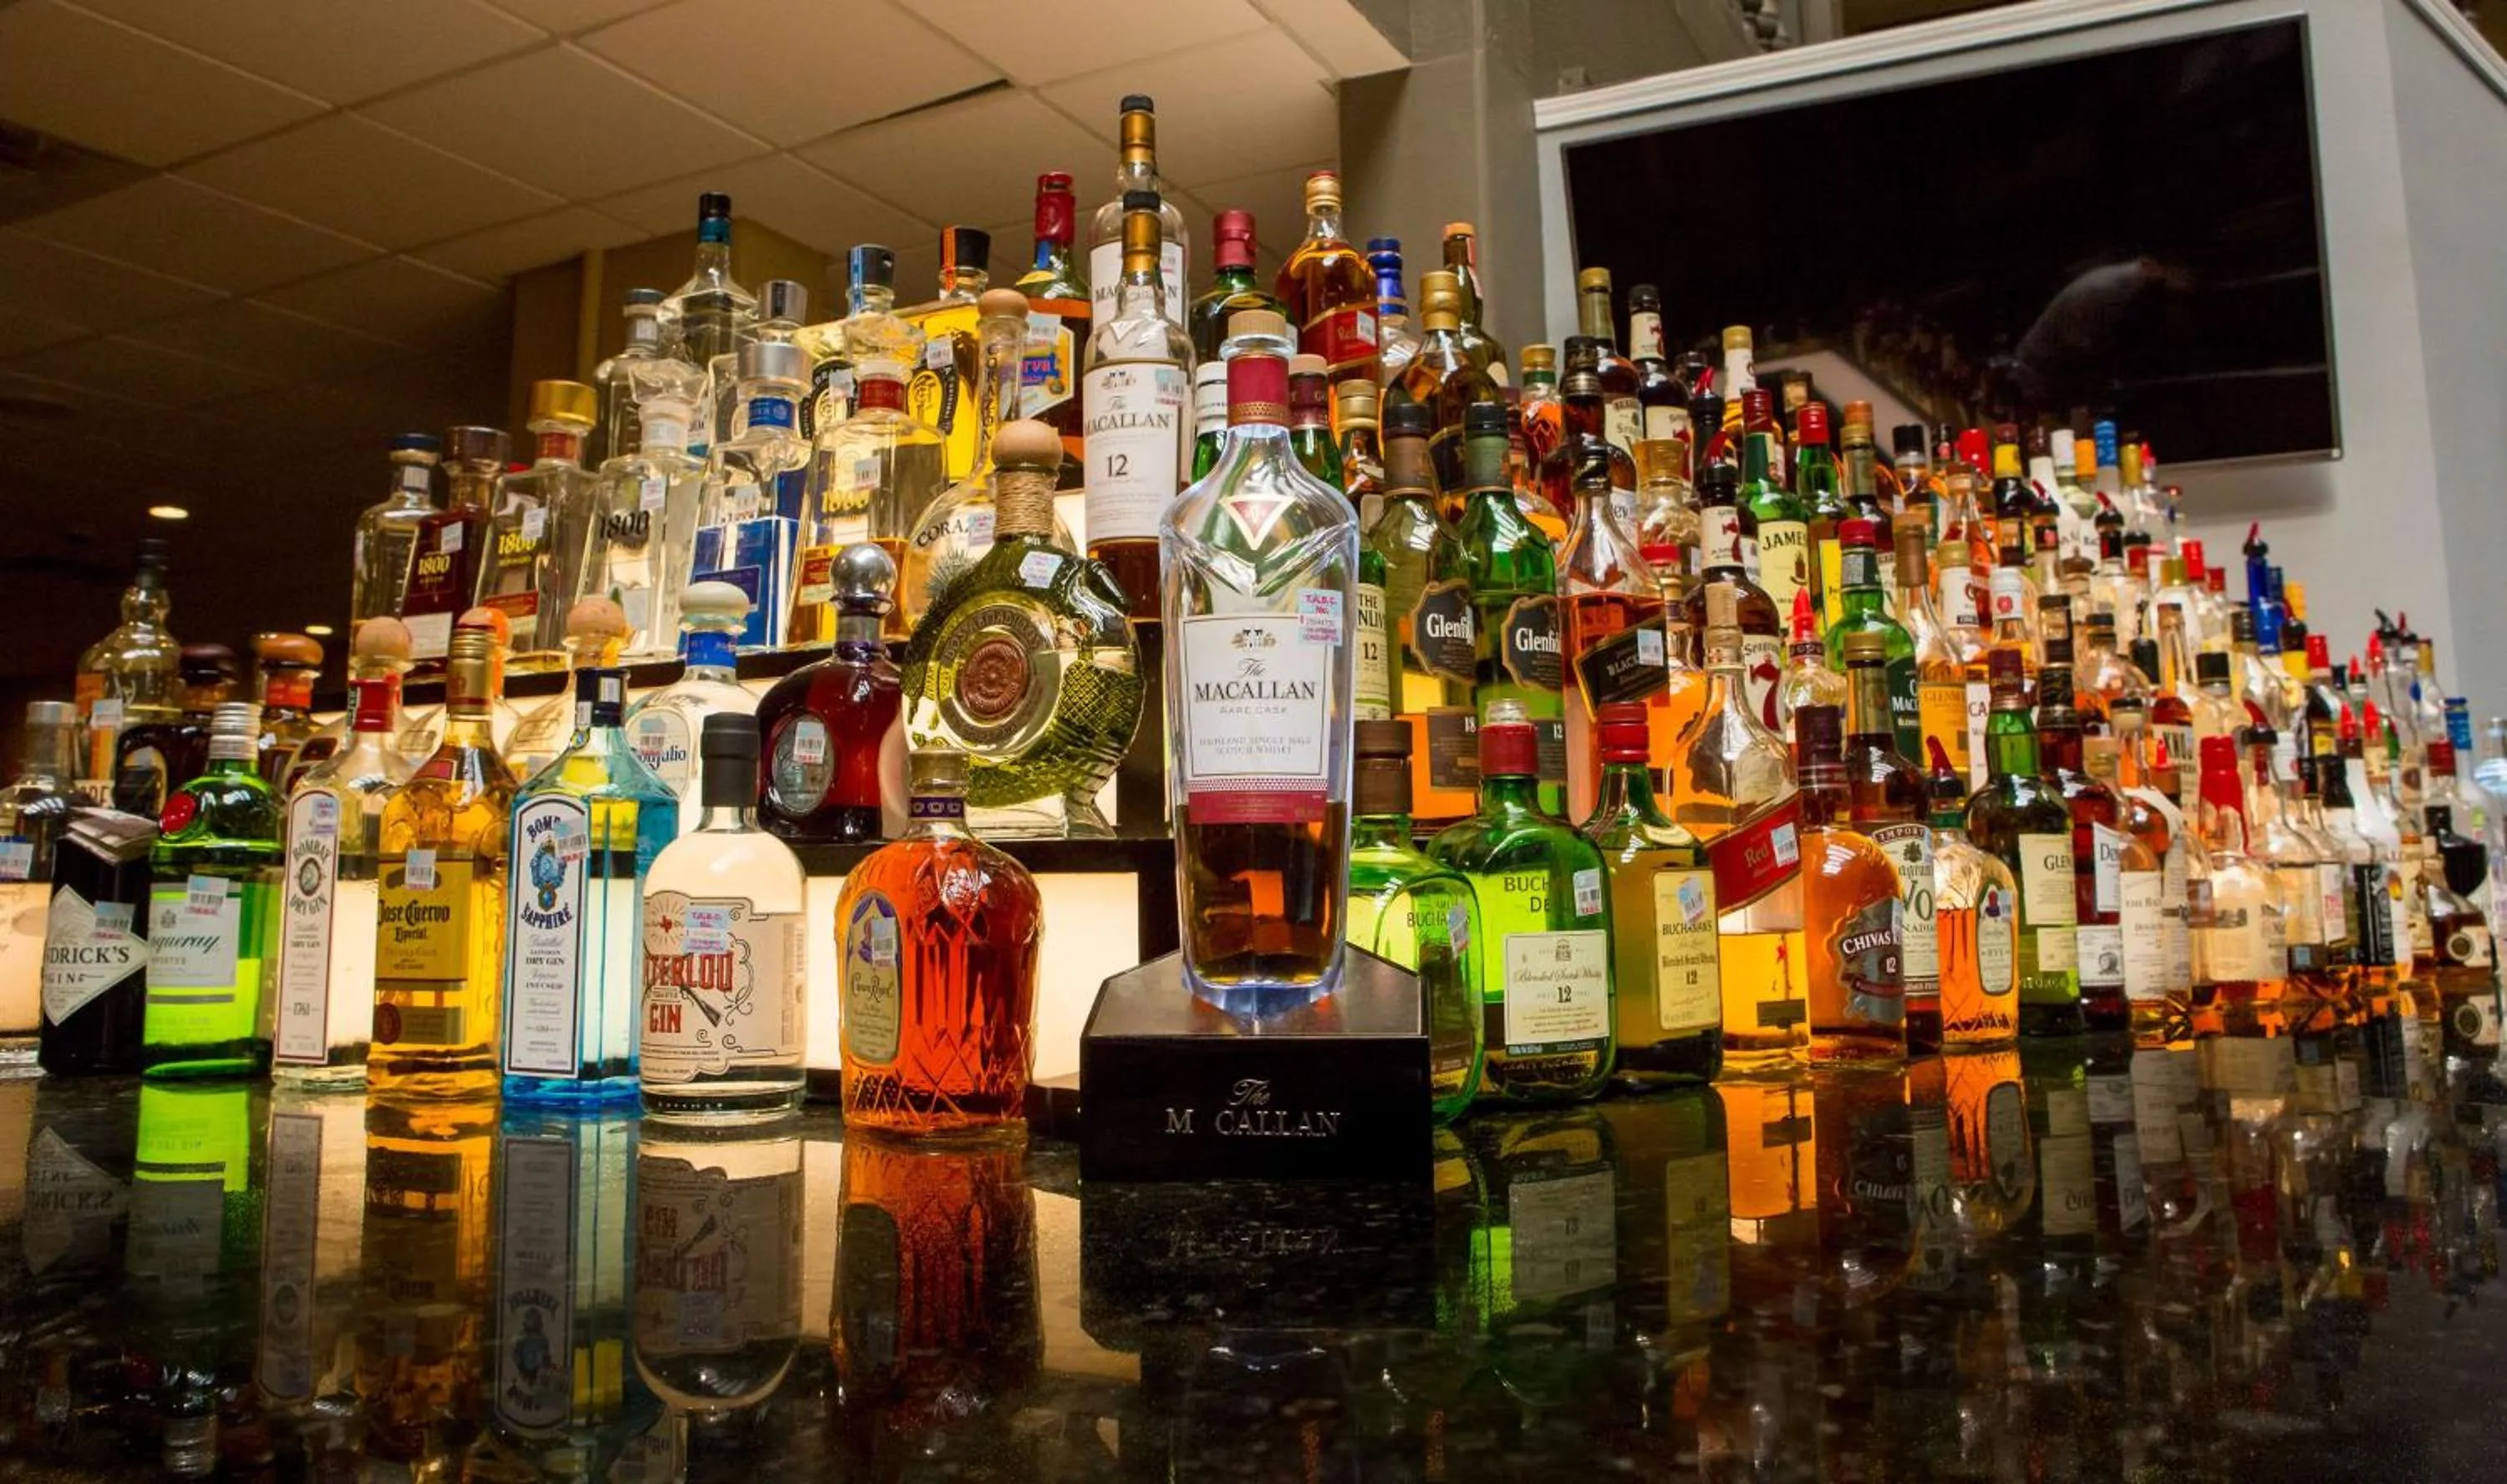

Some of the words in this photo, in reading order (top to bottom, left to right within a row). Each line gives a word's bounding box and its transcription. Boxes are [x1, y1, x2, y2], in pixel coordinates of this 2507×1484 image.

[1107, 454, 1129, 479] 12
[598, 509, 650, 540] 1800
[916, 518, 970, 548] CORA
[418, 552, 451, 576] 1800
[1359, 593, 1378, 609] THE
[1363, 641, 1378, 661] 12
[1239, 658, 1266, 677] The
[1605, 654, 1640, 677] BLAC
[1194, 681, 1317, 702] MACALLAN
[1464, 716, 1477, 733] 18
[1553, 723, 1564, 739] 12
[1743, 840, 1770, 868] Red
[405, 898, 451, 927] Cuervo
[520, 902, 573, 930] SAPPHIRE
[151, 935, 221, 954] queray
[1843, 929, 1893, 955] CHIVAS
[45, 944, 130, 964] DRICK'S
[1885, 956, 1897, 974] 12
[1686, 968, 1698, 985] 12
[1556, 985, 1572, 1004] 12
[649, 1004, 683, 1034] GIN
[1227, 1078, 1271, 1105] The
